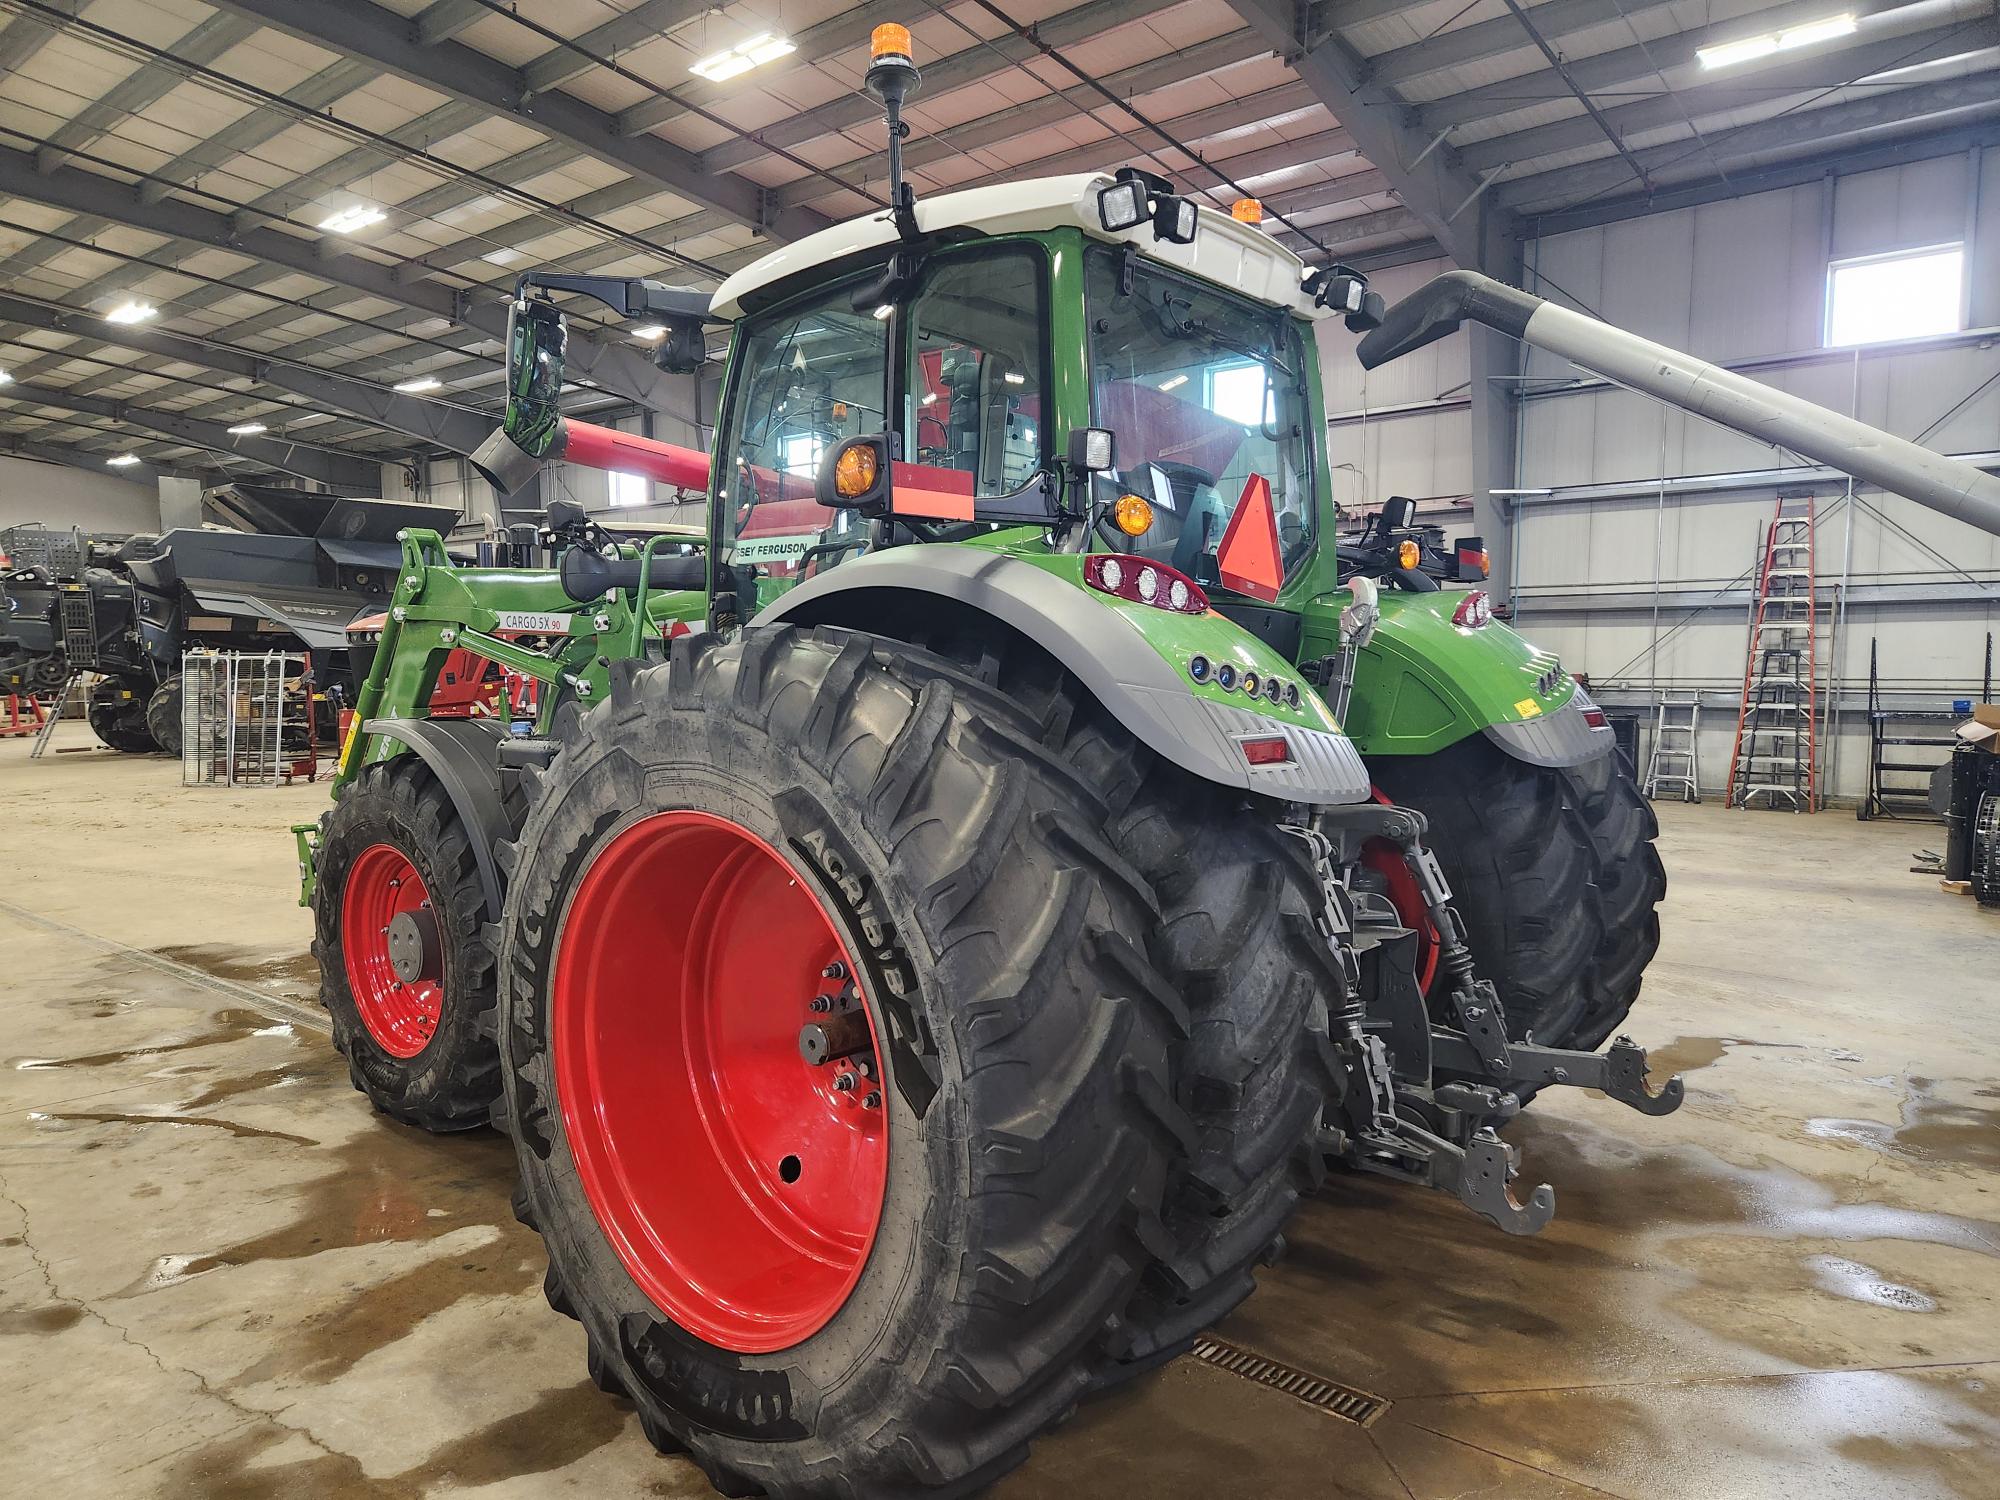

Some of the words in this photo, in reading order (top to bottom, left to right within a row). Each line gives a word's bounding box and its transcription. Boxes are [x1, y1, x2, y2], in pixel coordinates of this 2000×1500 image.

[757, 543, 807, 555] FERGUSON
[506, 615, 537, 630] CARGO
[551, 620, 561, 630] 90
